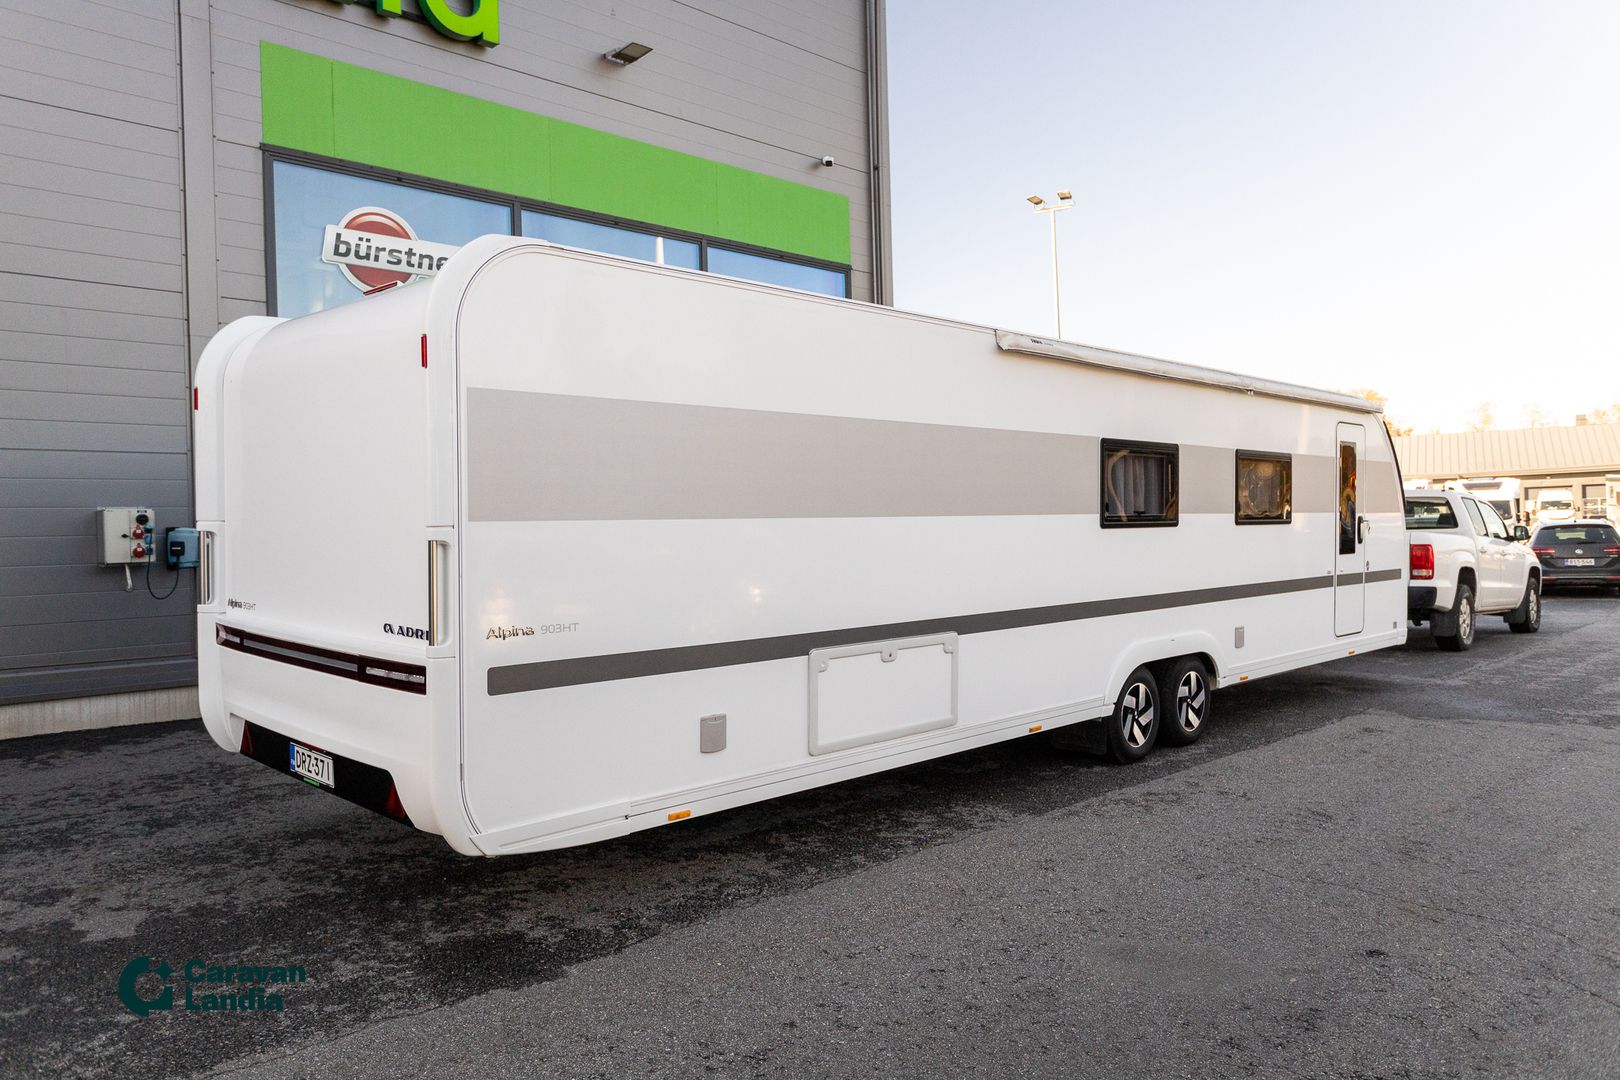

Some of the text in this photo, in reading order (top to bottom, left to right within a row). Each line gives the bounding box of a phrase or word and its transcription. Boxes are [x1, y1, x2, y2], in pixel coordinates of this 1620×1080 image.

[486, 622, 580, 641] Alpina 903HT
[295, 749, 330, 782] DRZ-371
